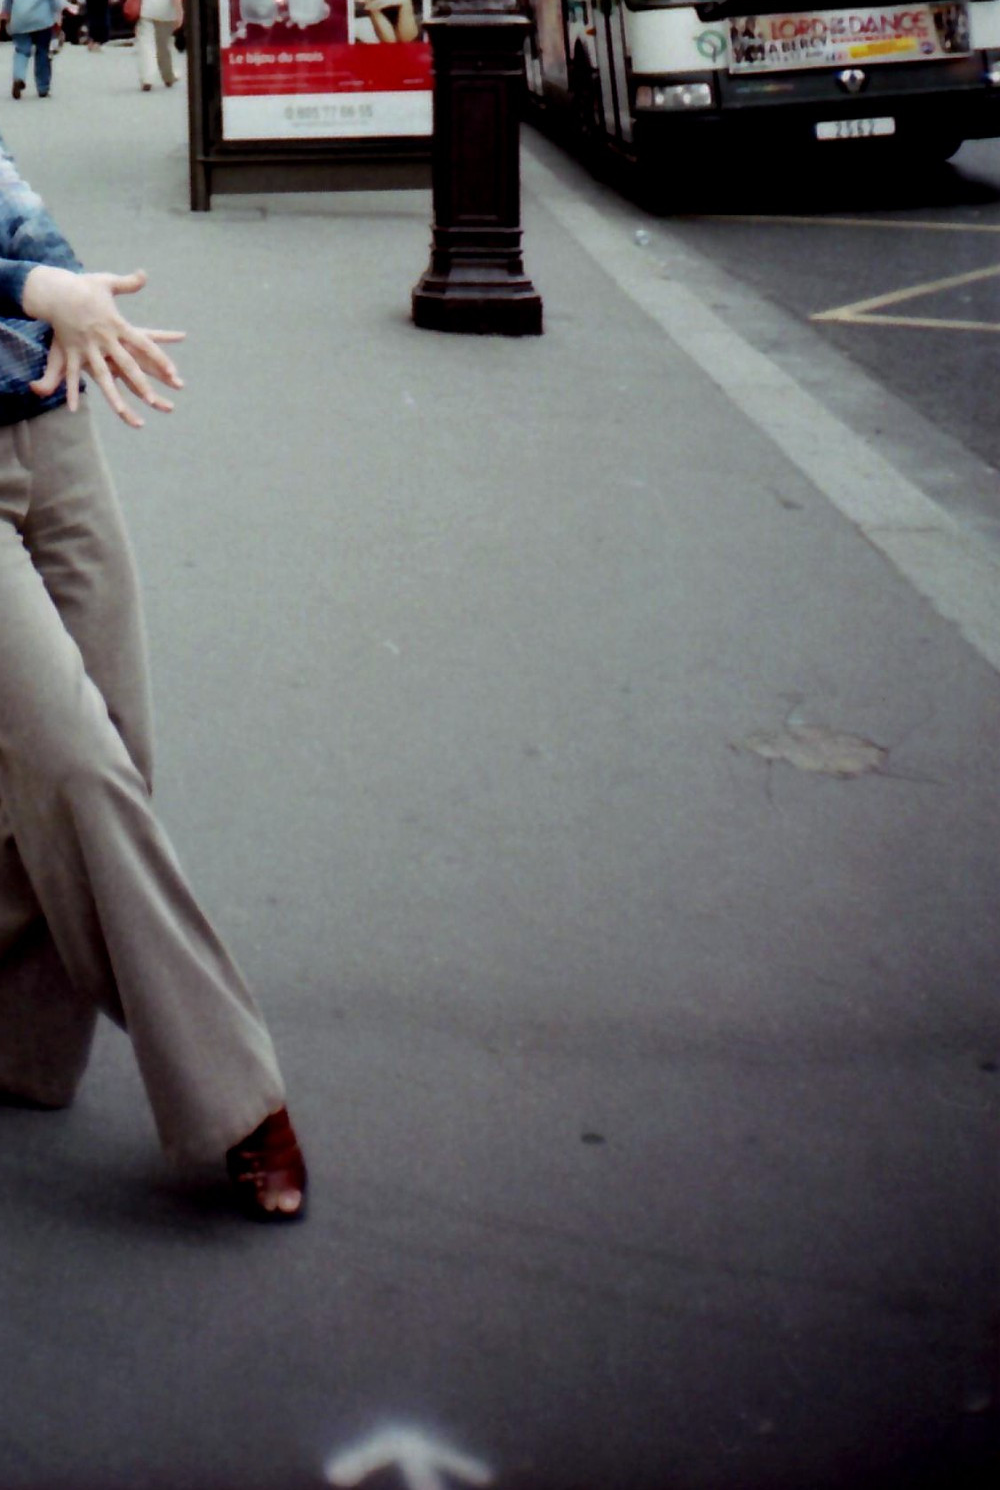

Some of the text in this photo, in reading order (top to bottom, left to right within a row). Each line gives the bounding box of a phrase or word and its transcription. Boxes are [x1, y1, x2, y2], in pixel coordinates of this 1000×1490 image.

[770, 17, 828, 41] LORD
[848, 11, 928, 35] DANCE
[229, 51, 324, 66] Le bijou du mois
